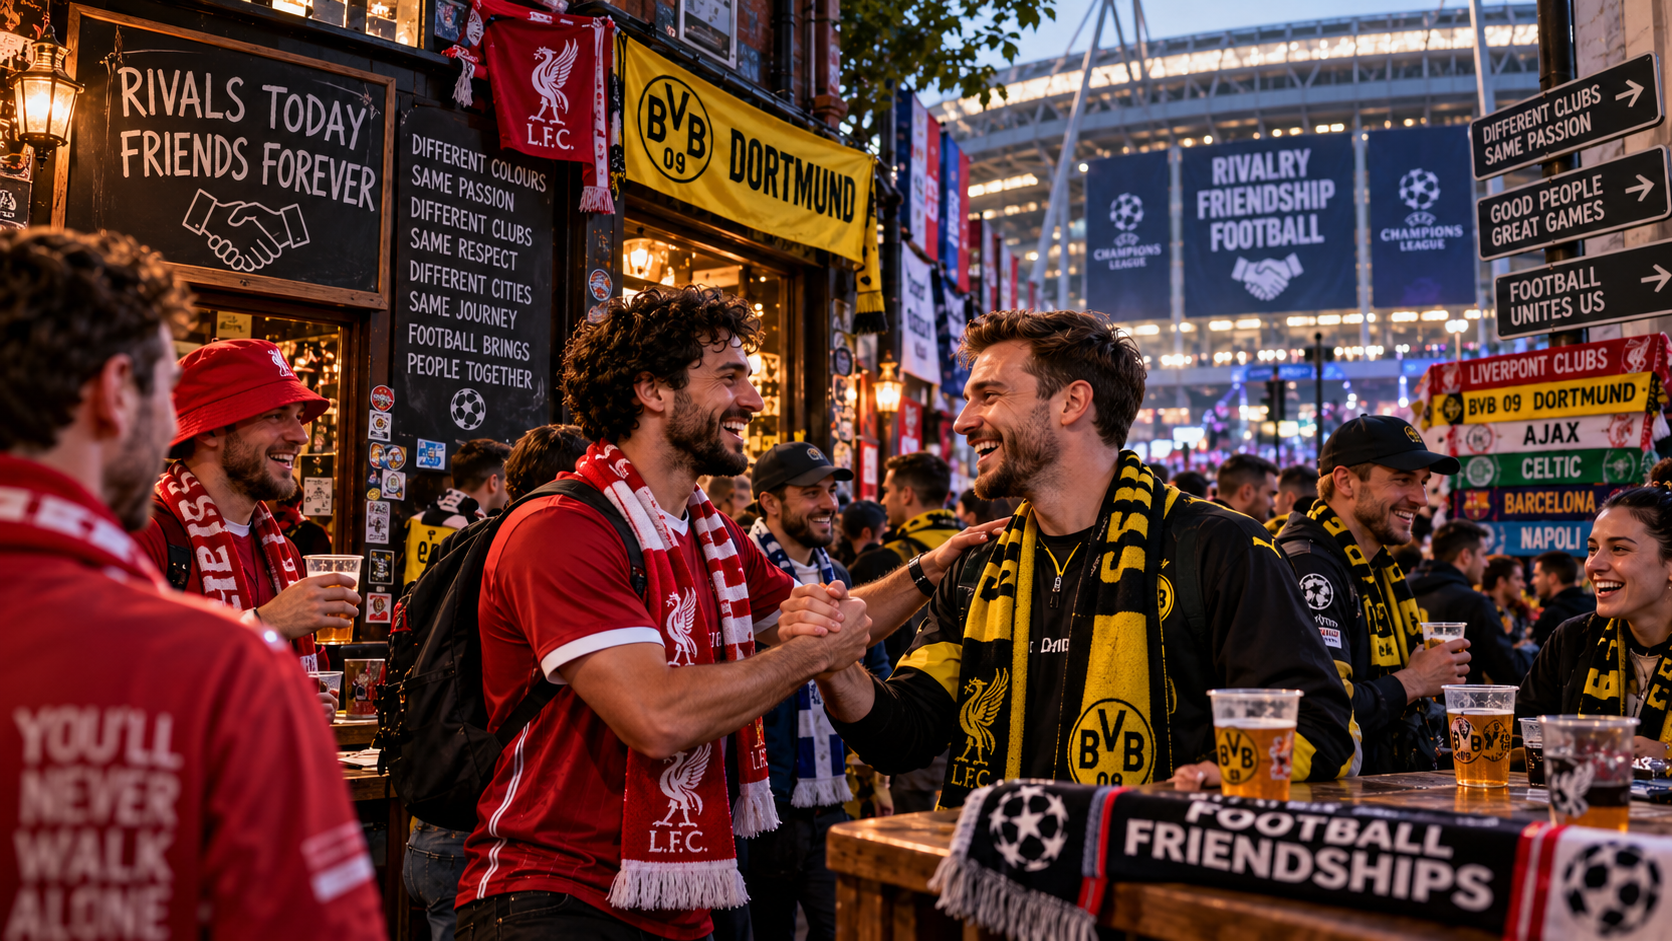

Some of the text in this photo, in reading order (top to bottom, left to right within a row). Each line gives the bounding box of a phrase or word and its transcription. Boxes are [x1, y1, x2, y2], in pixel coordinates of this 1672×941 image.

[118, 67, 366, 150] RIVALS TODAY
[647, 82, 706, 160] BVB
[1483, 84, 1601, 144] DIFFERENT CLUBS
[526, 123, 574, 150] L.F.C.
[1485, 112, 1592, 166] SAME PASSION
[120, 130, 376, 212] FRIENDS FOREVER
[412, 133, 547, 193] DIFFERENT COLOURS
[663, 147, 686, 174] 09
[729, 127, 856, 224] DORTMUND
[1212, 148, 1312, 186] RIVALRY
[411, 165, 515, 213] SAME PASSION
[1197, 178, 1336, 220] FRIENDSHIP
[1490, 174, 1603, 224] GOOD PEOPLE
[411, 196, 533, 247] DIFFERENT CLUBS
[1210, 214, 1325, 252] FOOTBALL
[1380, 224, 1464, 242] CHAMPIONS
[1492, 200, 1605, 247] GREAT GAMES
[410, 228, 518, 271] SAME RESPECT
[1094, 243, 1162, 261] CHAMPIONS
[1108, 257, 1147, 270] LEAGUE
[1400, 238, 1446, 252] LEAGUE
[410, 260, 532, 305] DIFFERENT CITIES
[1510, 266, 1601, 302] FOOTBALL
[409, 291, 517, 330] SAME JOURNEY
[1511, 291, 1605, 326] UNITES US
[408, 323, 530, 361] FOOTBALL BRINGS
[407, 352, 533, 390] PEOPLE TOGETHER
[1470, 347, 1608, 385] LIVERPONT CLUBS
[1468, 382, 1636, 416] BVB 09 DORTMUND
[1523, 421, 1580, 446] AJAX
[1521, 455, 1582, 480] CELTIC
[1504, 490, 1596, 514] BARCELONA
[1521, 526, 1580, 550] NAPOLI
[12, 704, 183, 770] YOU'LL
[1079, 708, 1145, 772] BVB
[1219, 732, 1254, 769] BVB
[19, 764, 181, 827] NEVER
[648, 829, 708, 854] L.F.C.
[1186, 799, 1454, 859] FOOTBALL
[14, 827, 175, 882] WALK
[1124, 817, 1494, 912] FRIENDSHIPS
[3, 882, 173, 941] ALONE
